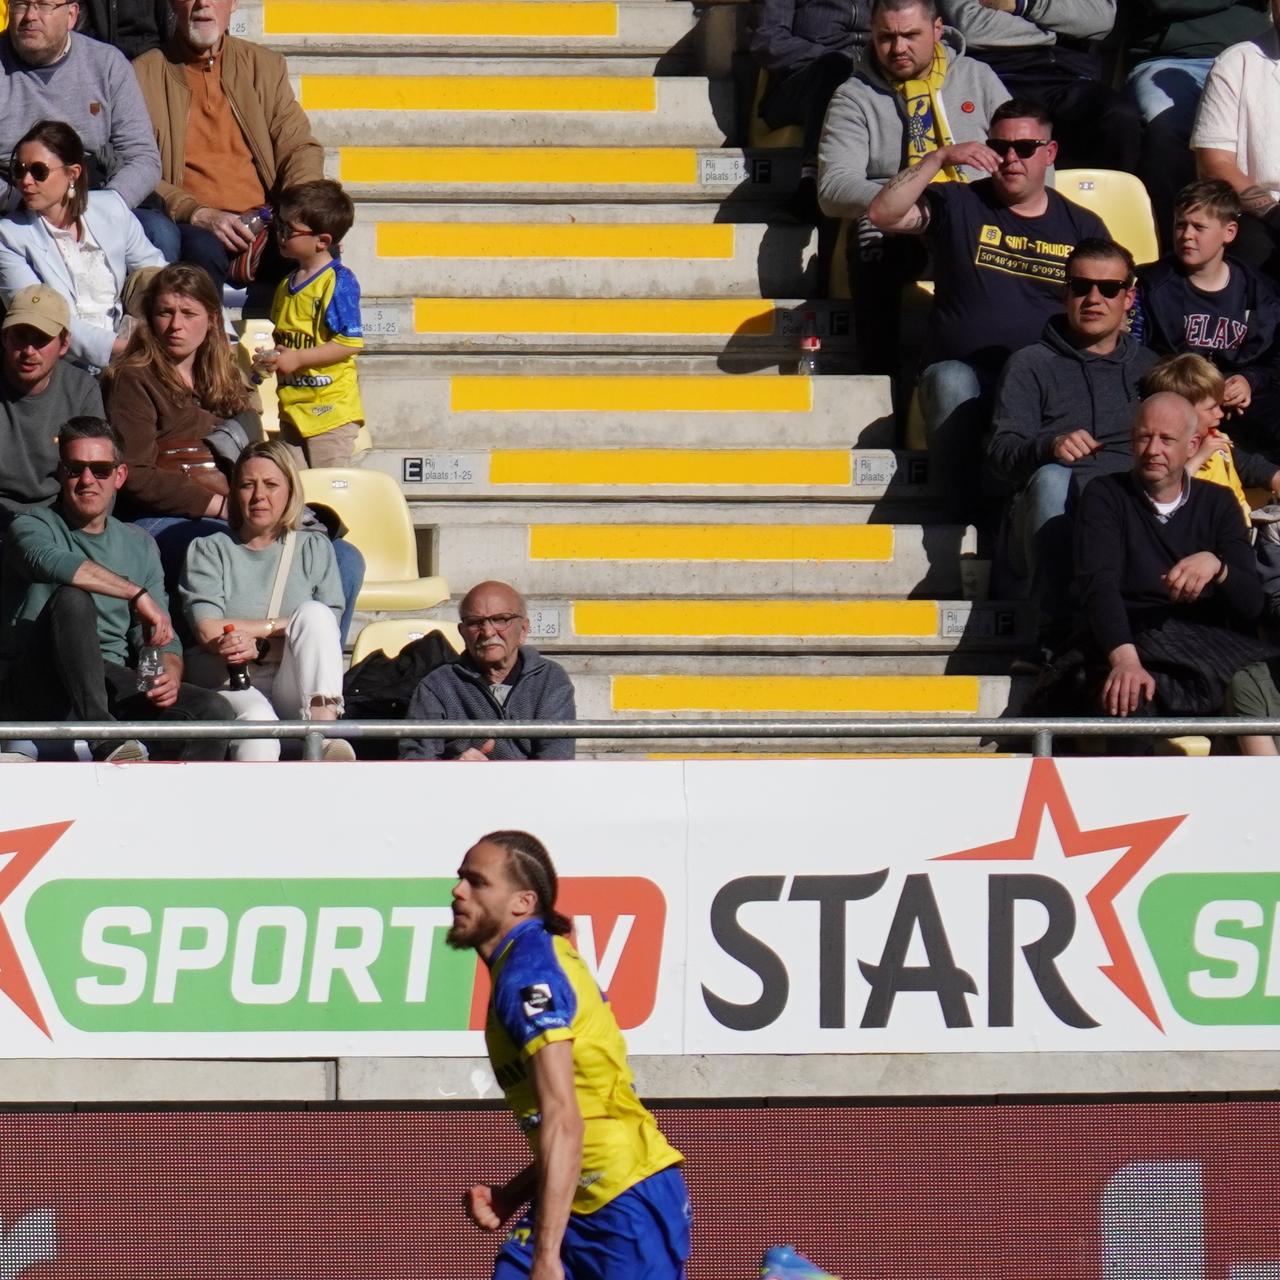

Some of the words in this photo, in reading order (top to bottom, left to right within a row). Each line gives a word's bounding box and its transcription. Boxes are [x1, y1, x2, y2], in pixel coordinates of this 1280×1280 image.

[705, 160, 716, 170] Rij
[1032, 264, 1067, 278] 5°09'59
[1184, 313, 1248, 350] ELAX
[404, 458, 422, 482] E
[75, 905, 450, 1005] SPORT
[701, 867, 1100, 1031] STAR
